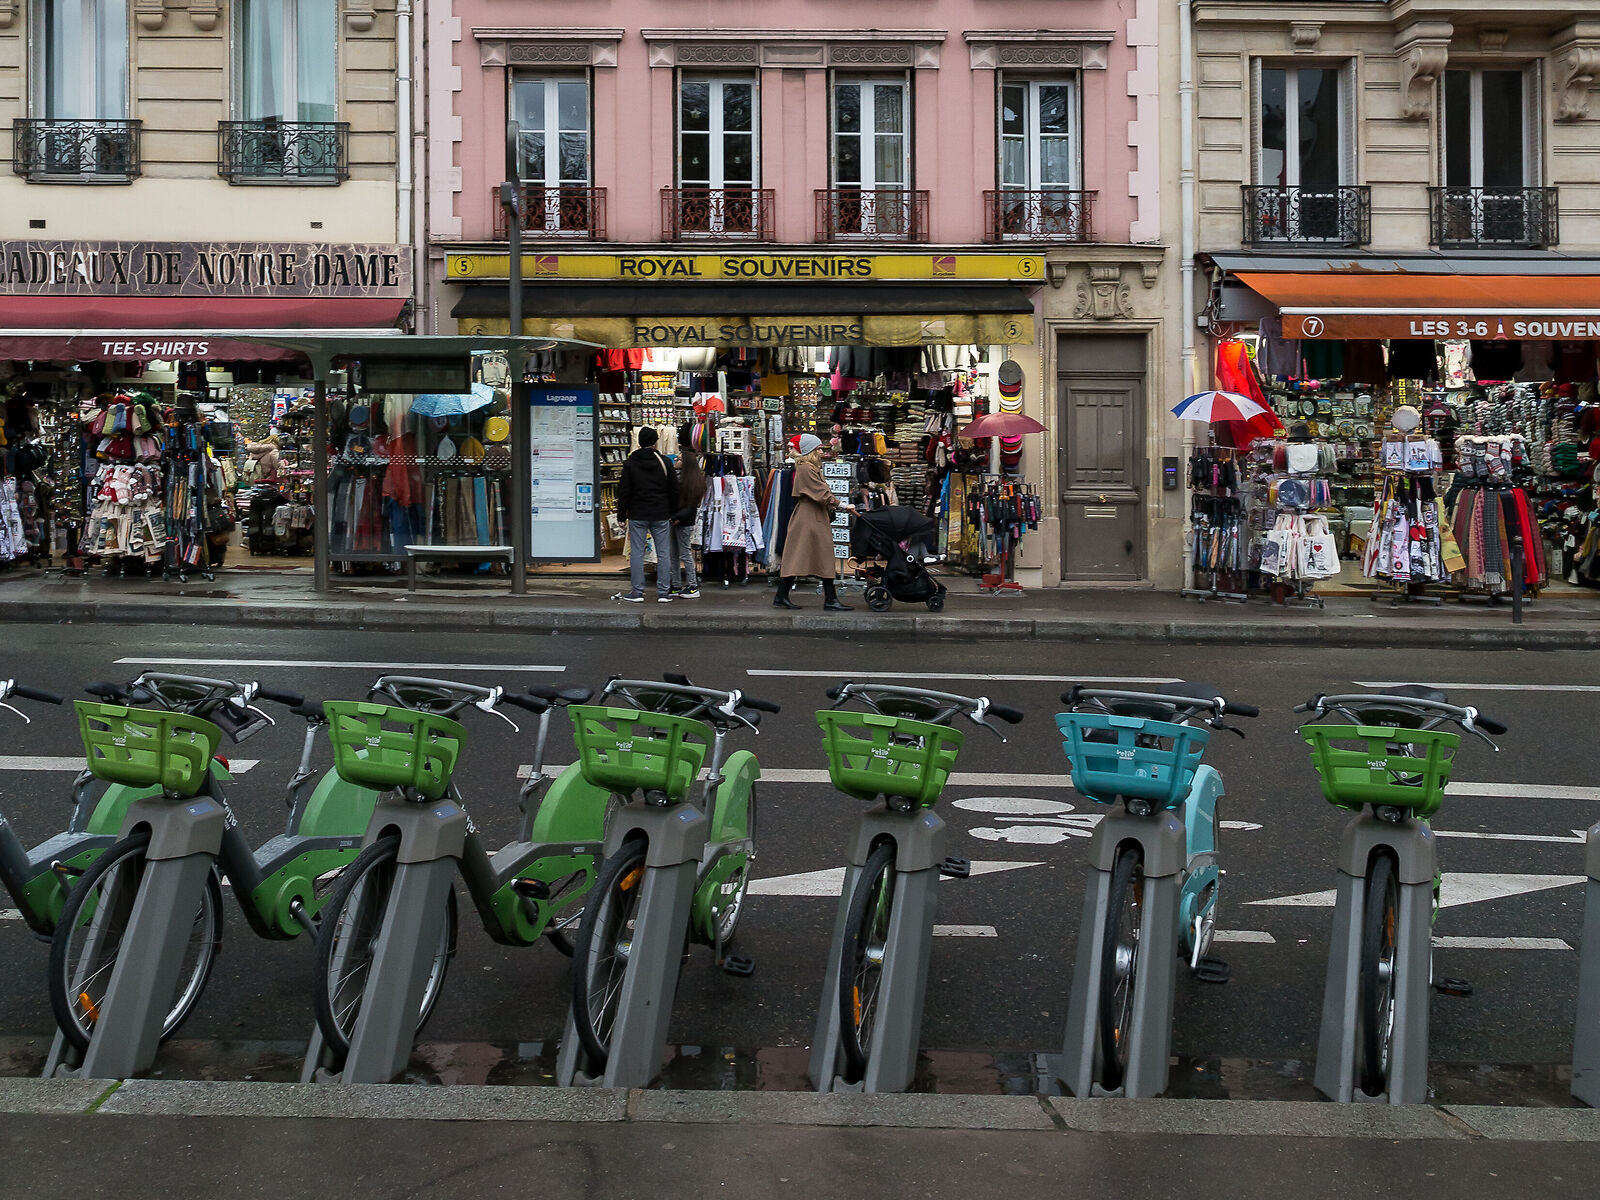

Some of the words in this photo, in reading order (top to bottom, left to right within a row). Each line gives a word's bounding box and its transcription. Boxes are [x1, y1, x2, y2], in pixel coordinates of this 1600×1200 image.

[145, 251, 182, 285] DE
[198, 252, 296, 286] NOTRE
[311, 254, 399, 287] DAME
[461, 260, 468, 272] 5
[620, 258, 702, 277] ROYAL
[723, 257, 872, 277] SOUVENIRS
[1024, 261, 1031, 273] 5
[634, 324, 714, 344] ROYAL
[719, 323, 865, 345] SOUVENIRS
[1010, 324, 1017, 336] 5
[1307, 320, 1318, 334] 7
[1410, 321, 1450, 336] LES
[1456, 320, 1488, 336] 3-6
[1513, 320, 1600, 337] SOUVEN
[101, 341, 209, 356] TEE-SHIRTS
[546, 395, 577, 403] Lagrange
[826, 467, 849, 476] PARIS
